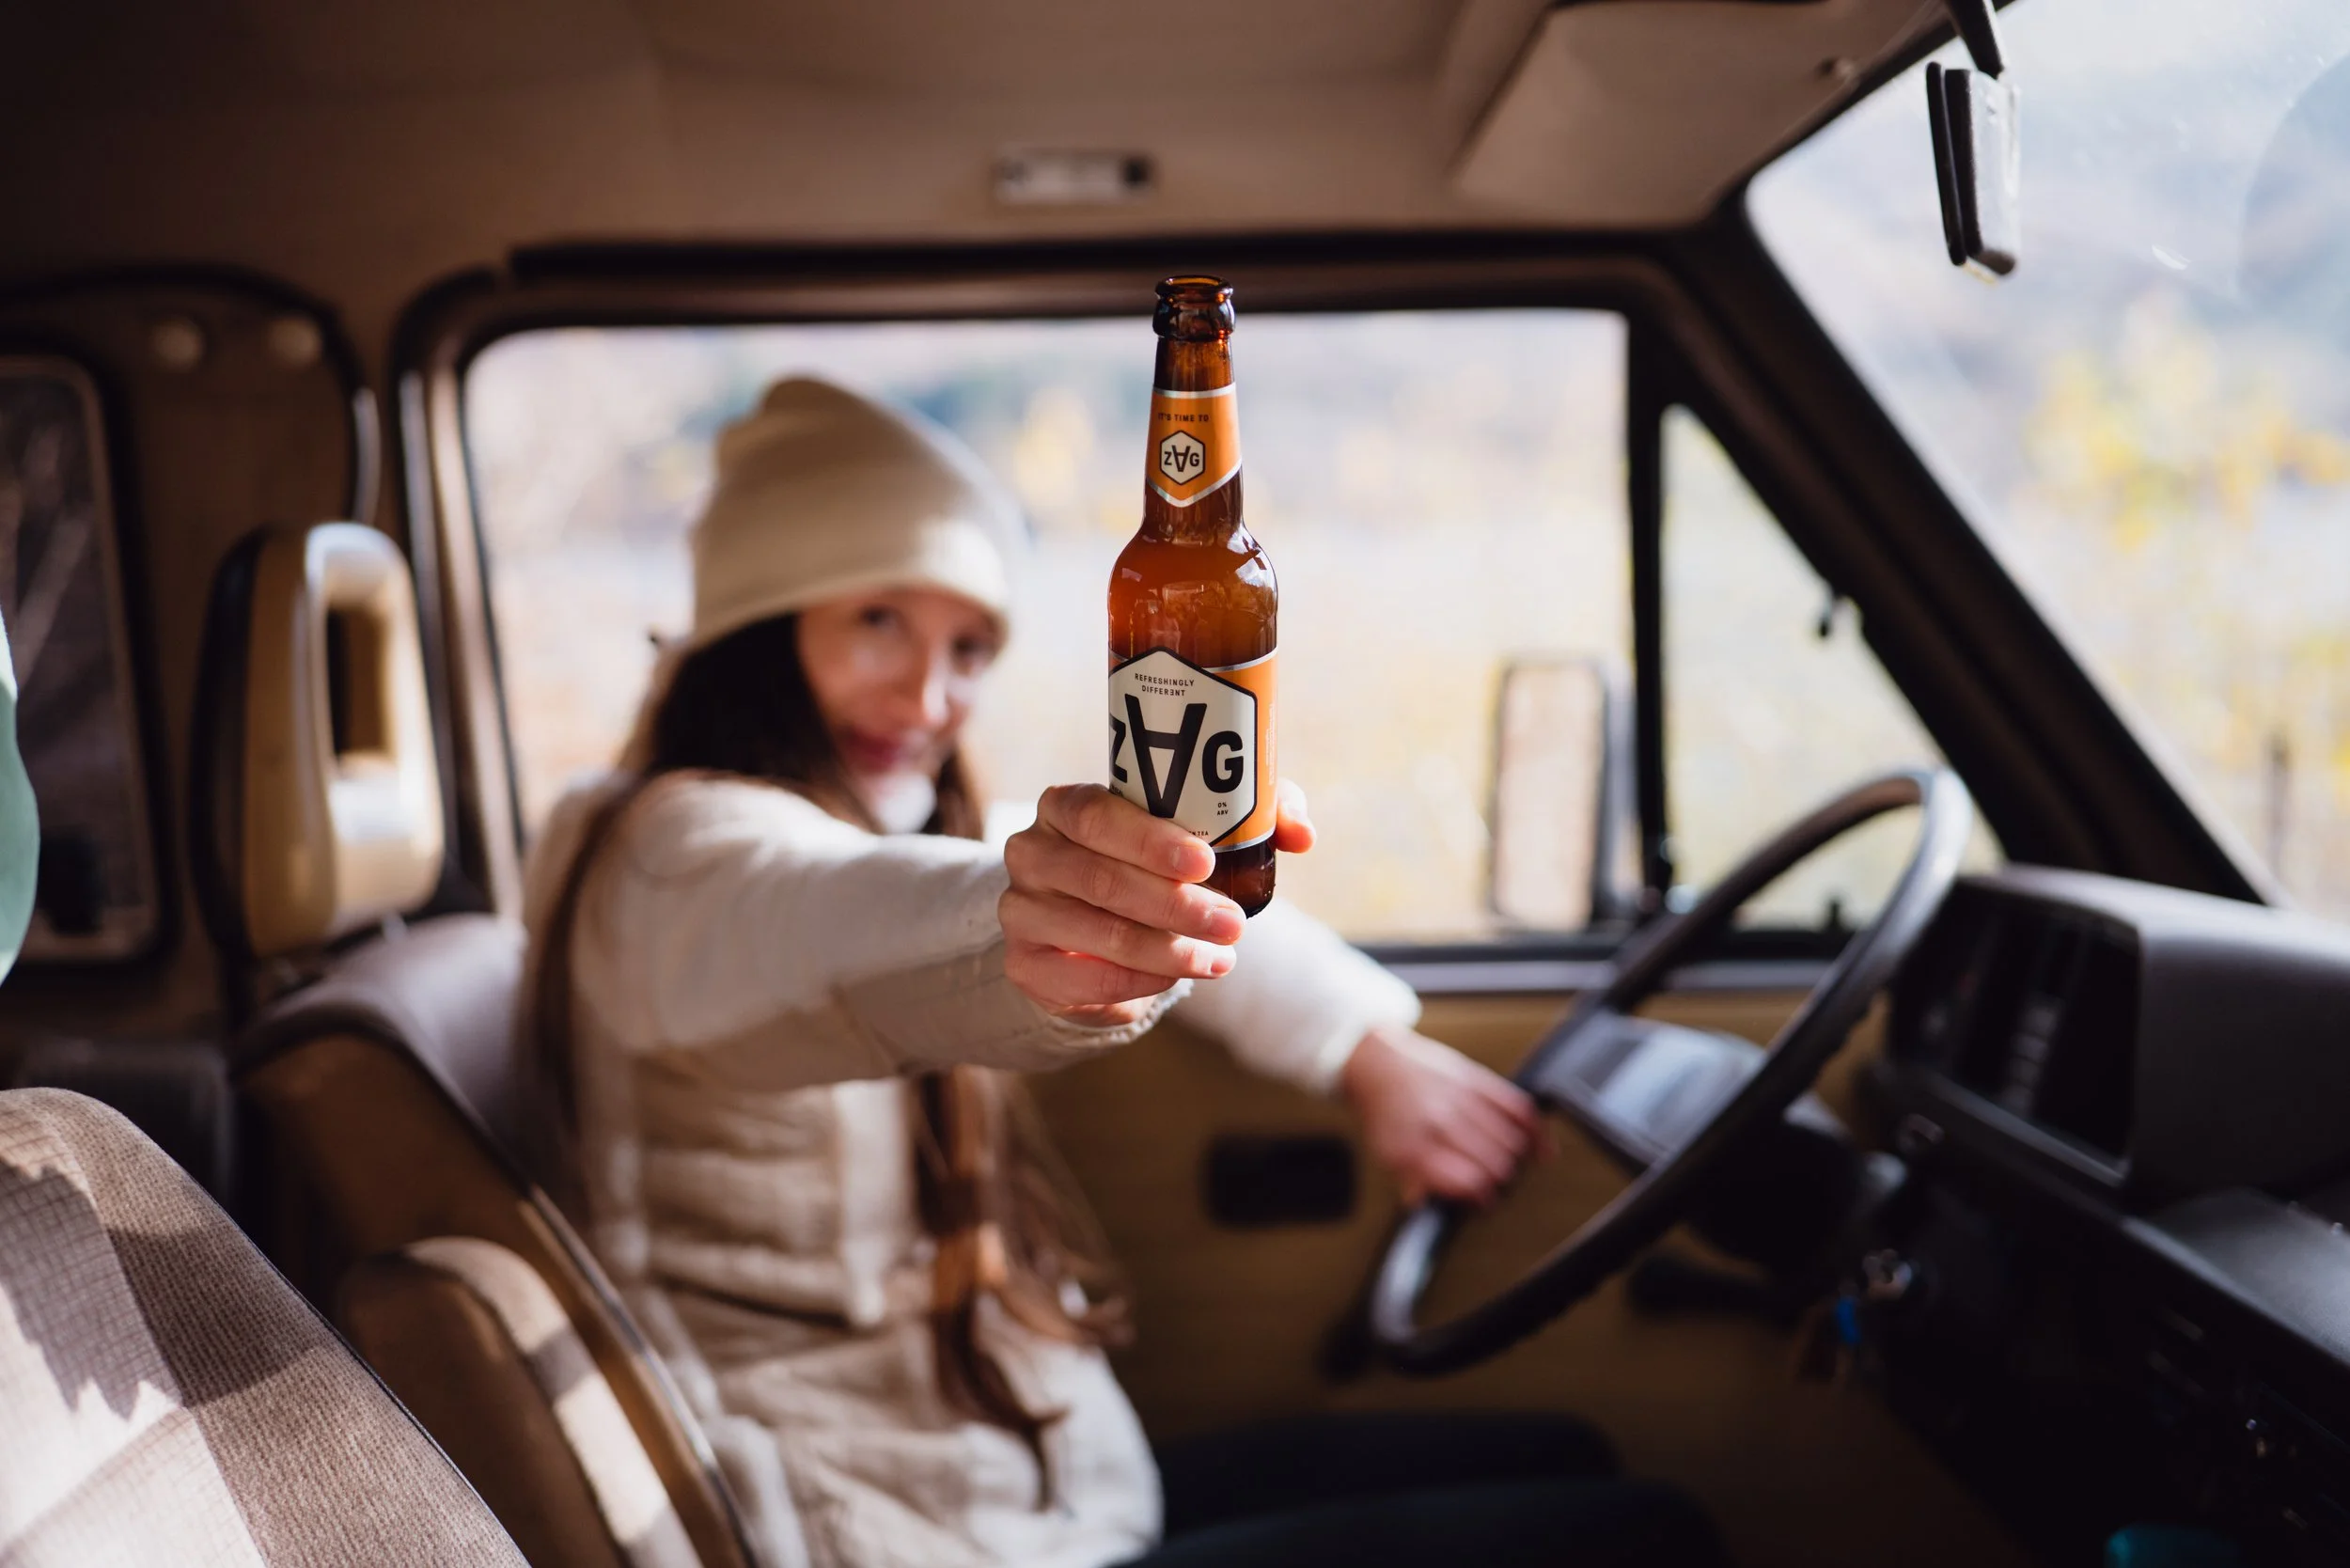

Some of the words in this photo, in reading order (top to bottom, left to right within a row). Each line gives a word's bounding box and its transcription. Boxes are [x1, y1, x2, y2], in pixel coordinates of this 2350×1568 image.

[1157, 413, 1171, 421] IT'S
[1174, 414, 1195, 422] TIME
[1198, 414, 1210, 422] TO
[1135, 673, 1195, 686] REFRESHINGLY
